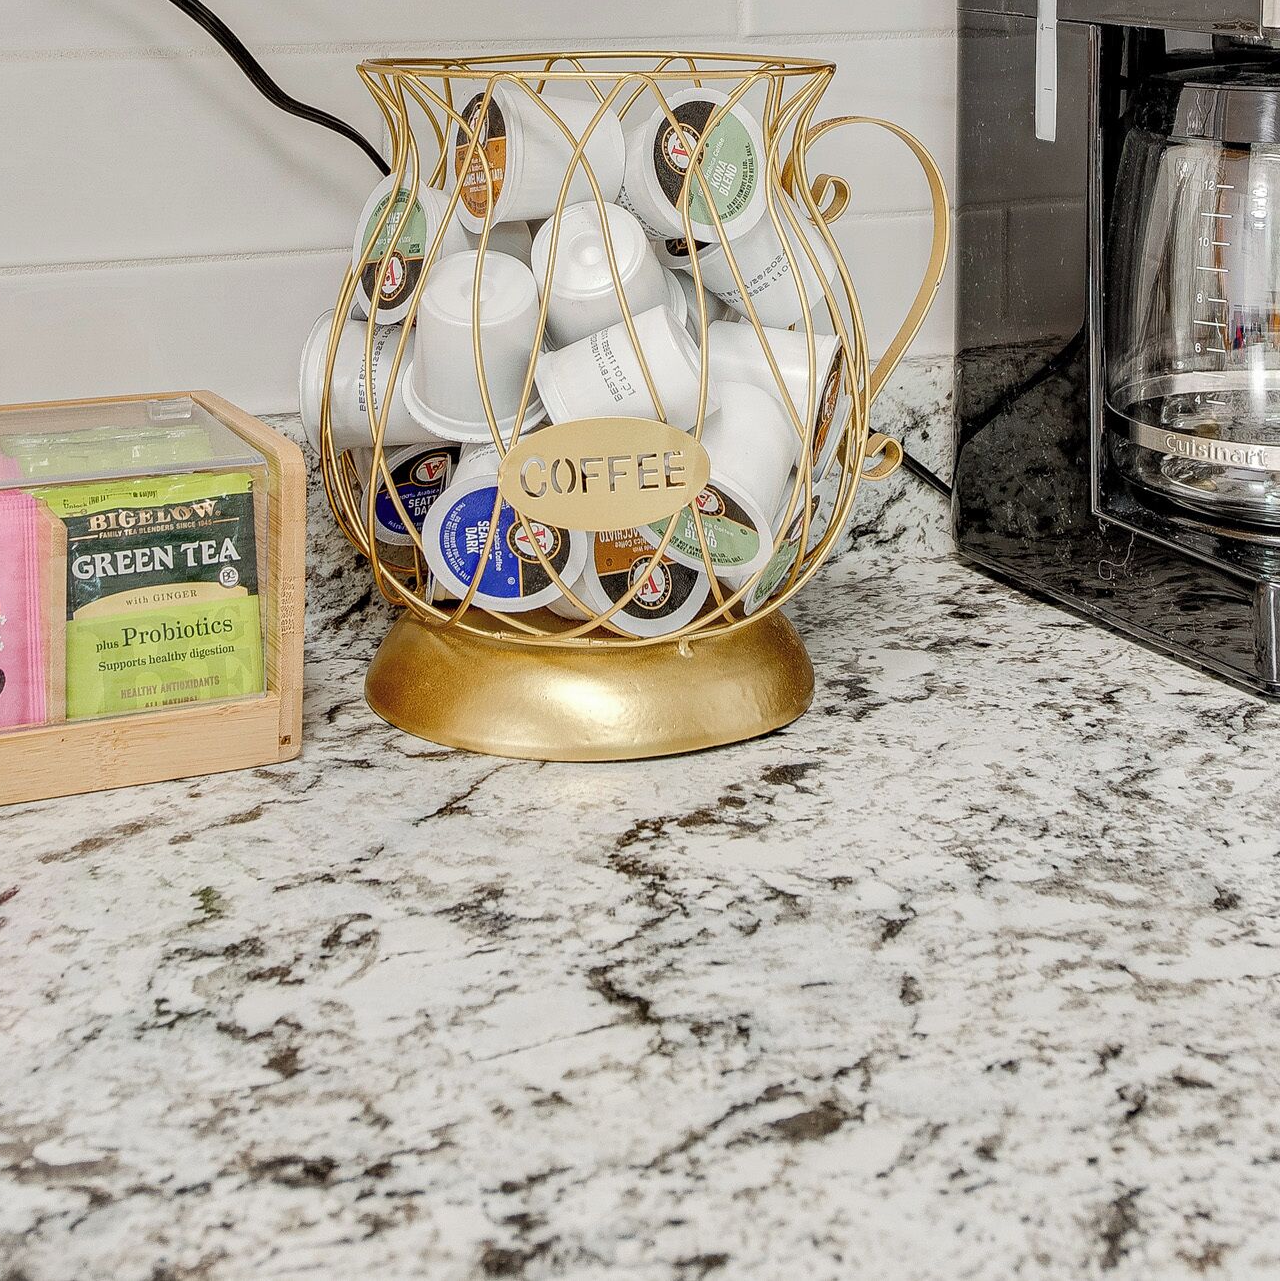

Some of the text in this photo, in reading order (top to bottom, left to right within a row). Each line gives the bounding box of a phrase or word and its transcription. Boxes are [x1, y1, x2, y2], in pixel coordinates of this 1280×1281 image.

[1040, 23, 1044, 31] 4
[710, 160, 728, 189] KONA
[720, 163, 738, 196] BLEND
[1204, 180, 1215, 190] 12
[1198, 237, 1209, 246] 10
[1196, 294, 1202, 303] 8
[1195, 343, 1201, 352] 6
[604, 377, 623, 402] BEST
[1195, 396, 1201, 405] 4
[1166, 434, 1269, 467] Cuisinart
[520, 450, 687, 499] COFFEE
[408, 495, 439, 508] SEATT
[88, 499, 219, 532] BIGELOW
[99, 529, 123, 539] FAMILY
[123, 528, 137, 536] TEA
[138, 523, 174, 535] BLENDERS
[176, 521, 196, 529] SINCE
[464, 526, 479, 554] DARK
[599, 527, 638, 543] ACCHIATO
[682, 527, 720, 548] BLND
[71, 537, 241, 580] GREEN TEA
[494, 550, 504, 572] Coffee
[125, 589, 197, 606] with GINGER
[96, 617, 233, 652] plus Probiotics
[98, 644, 235, 672] Supports healthy digestion
[120, 676, 220, 700] HEALTHY ANTIOXIDANTS
